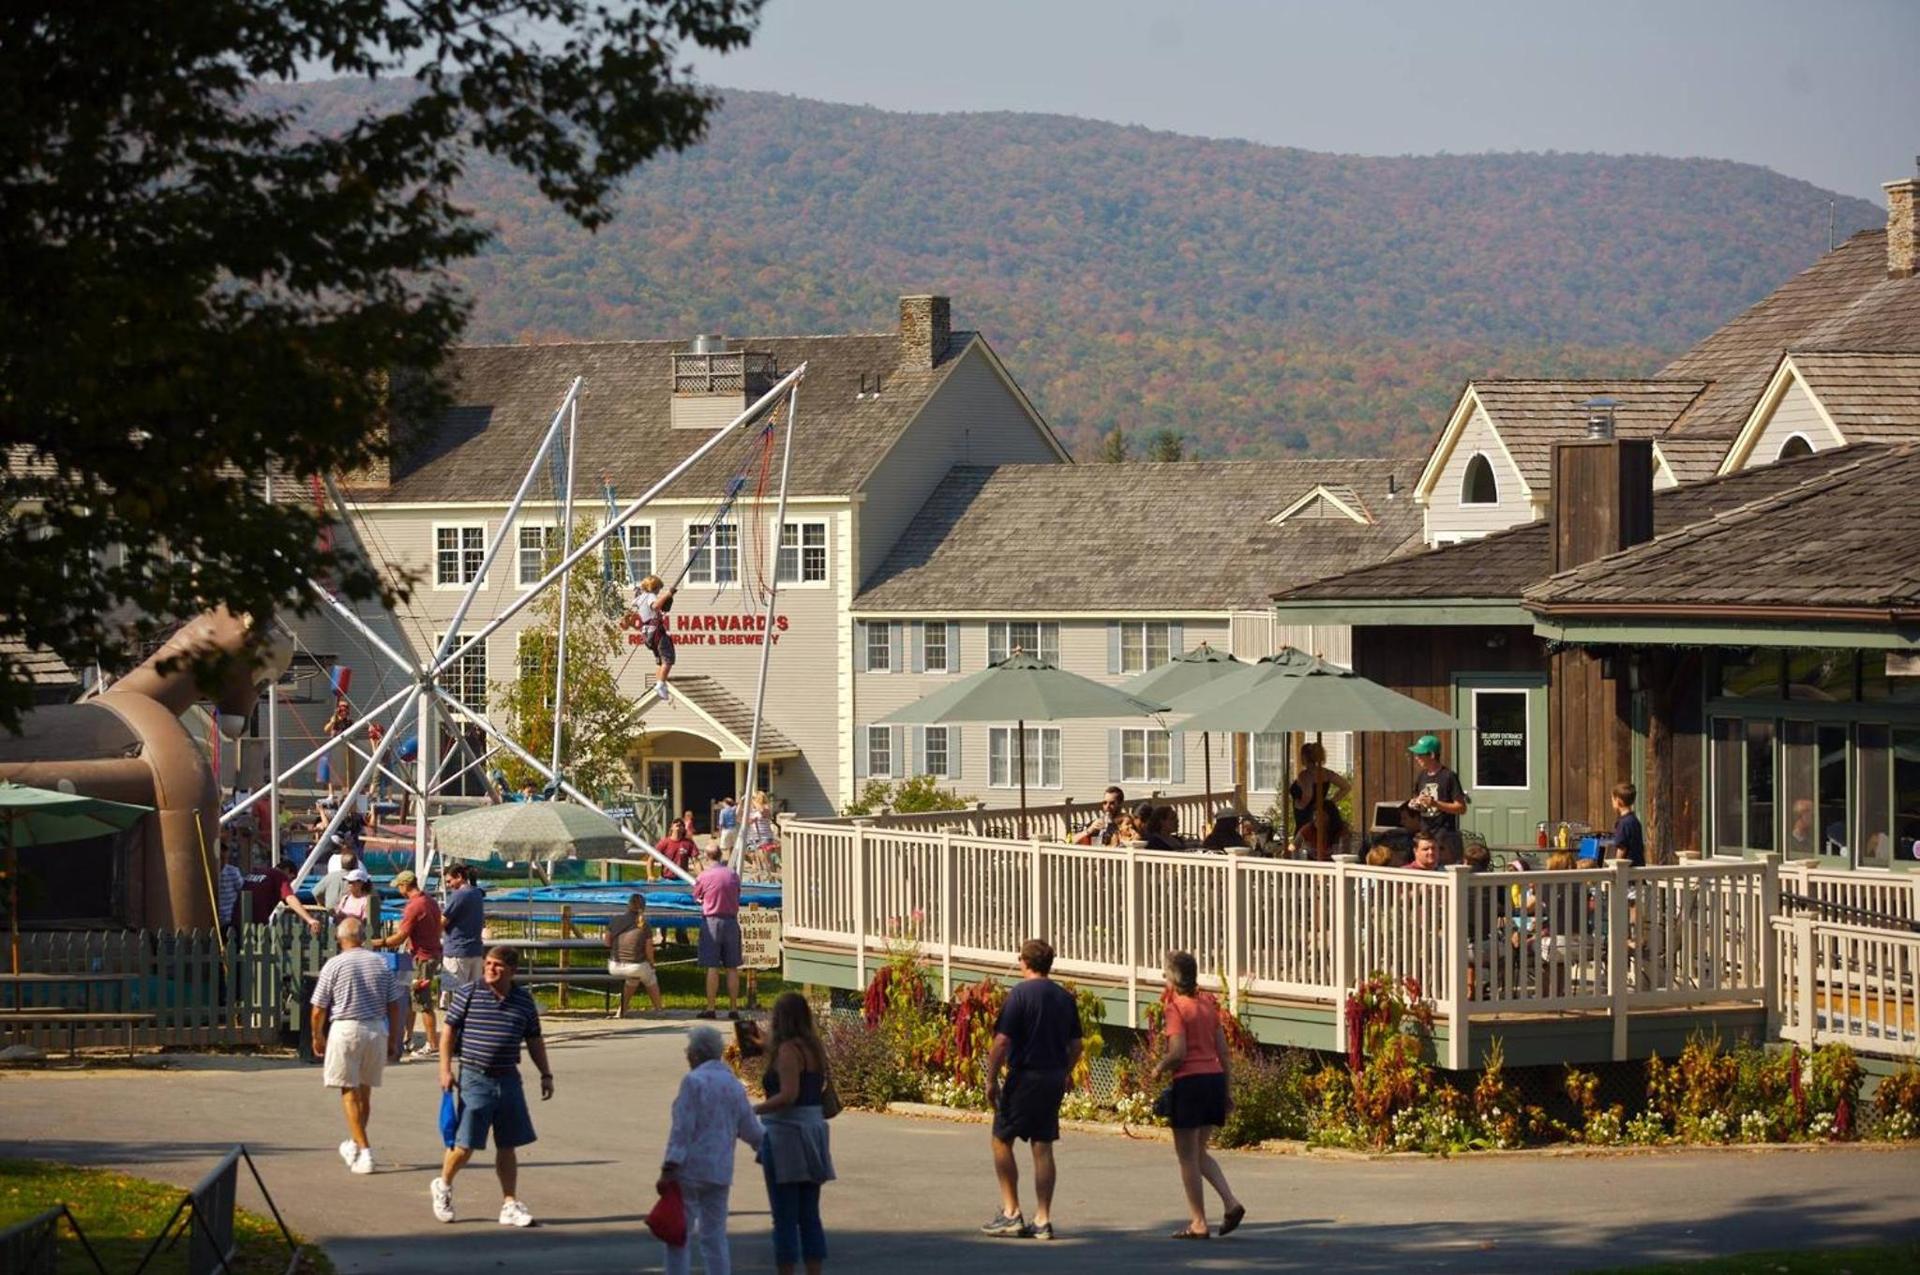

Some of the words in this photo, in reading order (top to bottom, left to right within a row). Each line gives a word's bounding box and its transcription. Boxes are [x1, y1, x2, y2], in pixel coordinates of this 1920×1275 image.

[677, 615, 789, 631] HARVARD'S
[707, 634, 716, 645] &
[719, 634, 780, 645] BREWEY
